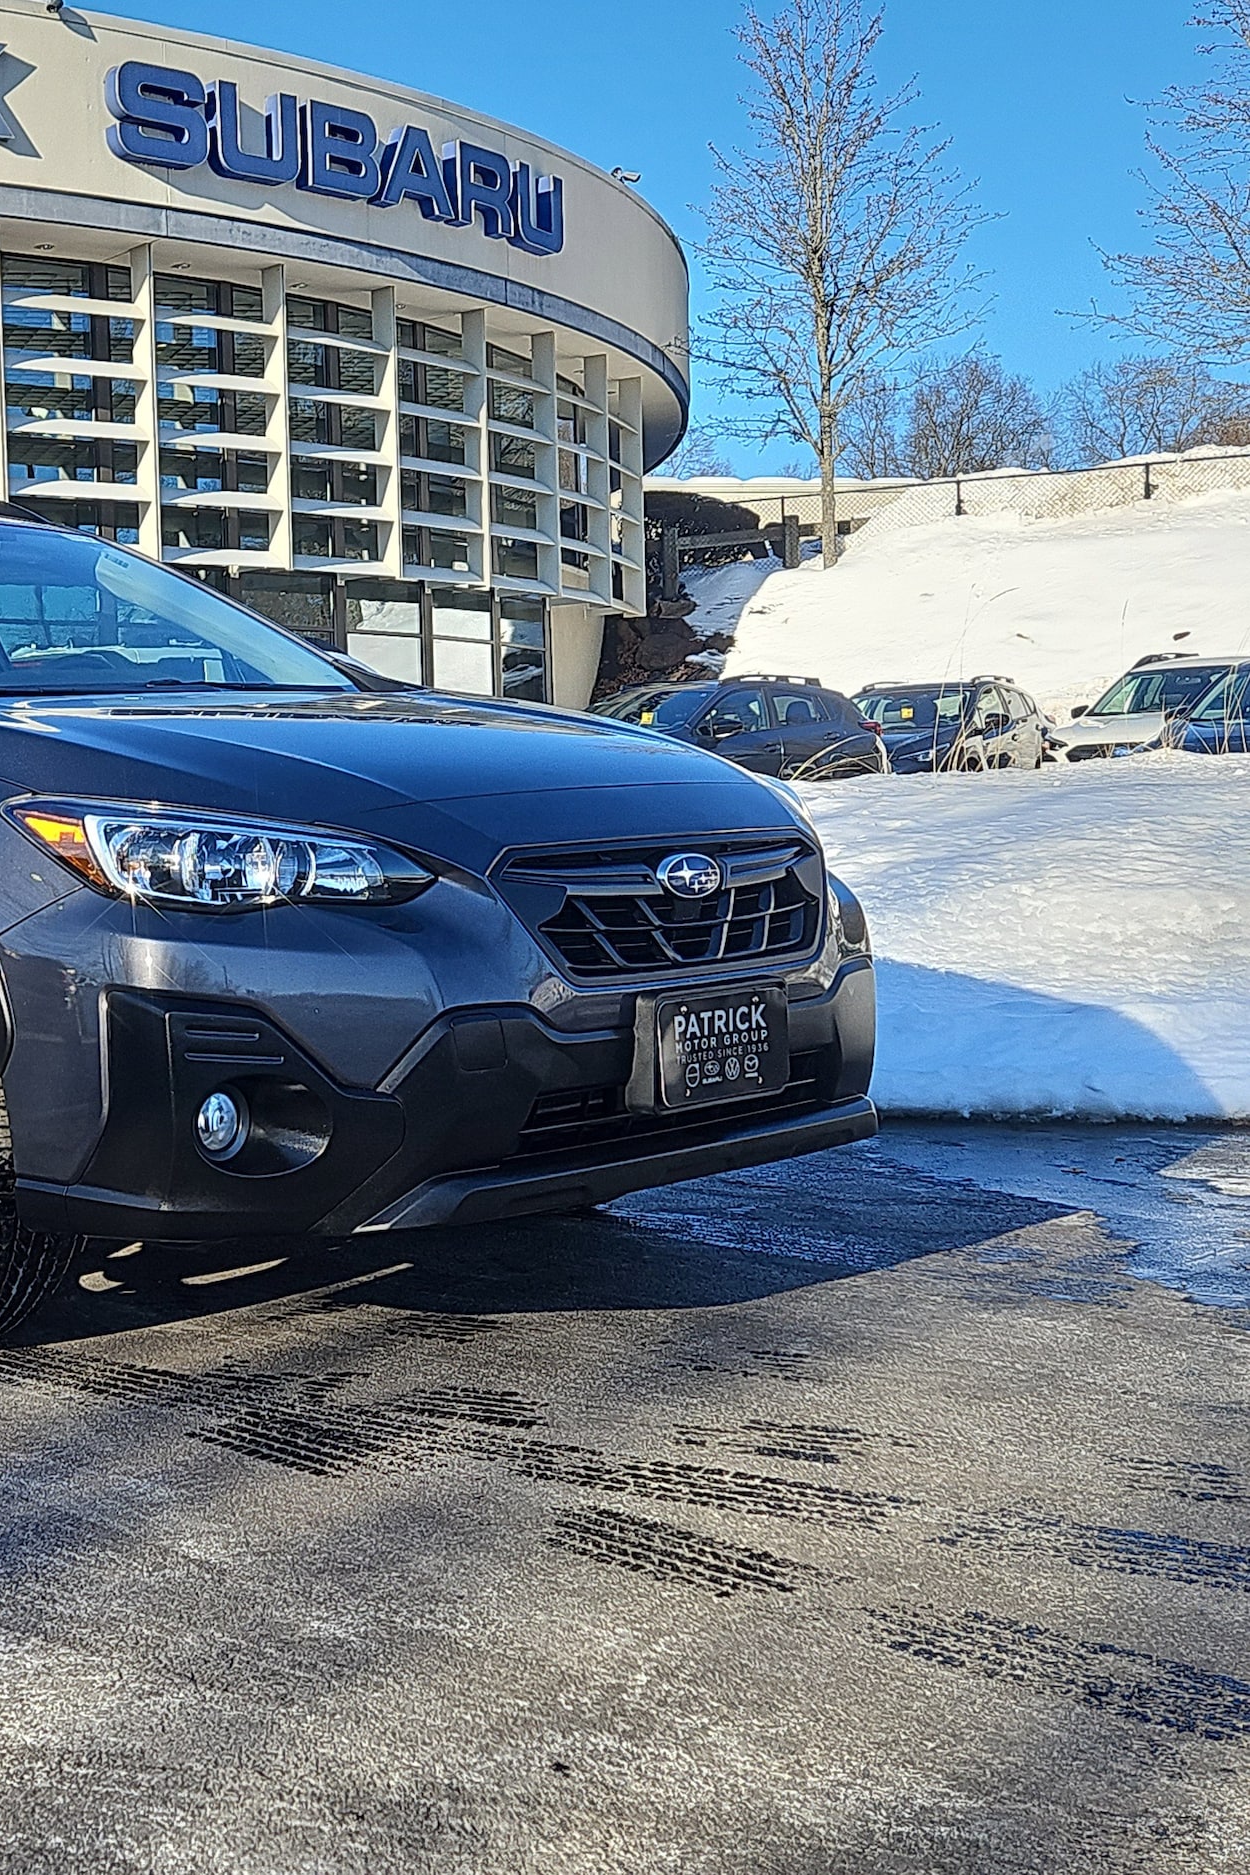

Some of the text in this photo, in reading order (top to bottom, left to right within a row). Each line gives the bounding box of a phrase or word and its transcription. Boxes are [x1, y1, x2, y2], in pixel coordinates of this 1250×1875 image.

[105, 60, 565, 257] SUBARU
[673, 1003, 767, 1041] PATRICK
[675, 1030, 768, 1054] MOTOR GROUP
[676, 1042, 769, 1065] TRUSTED SINCE 1936
